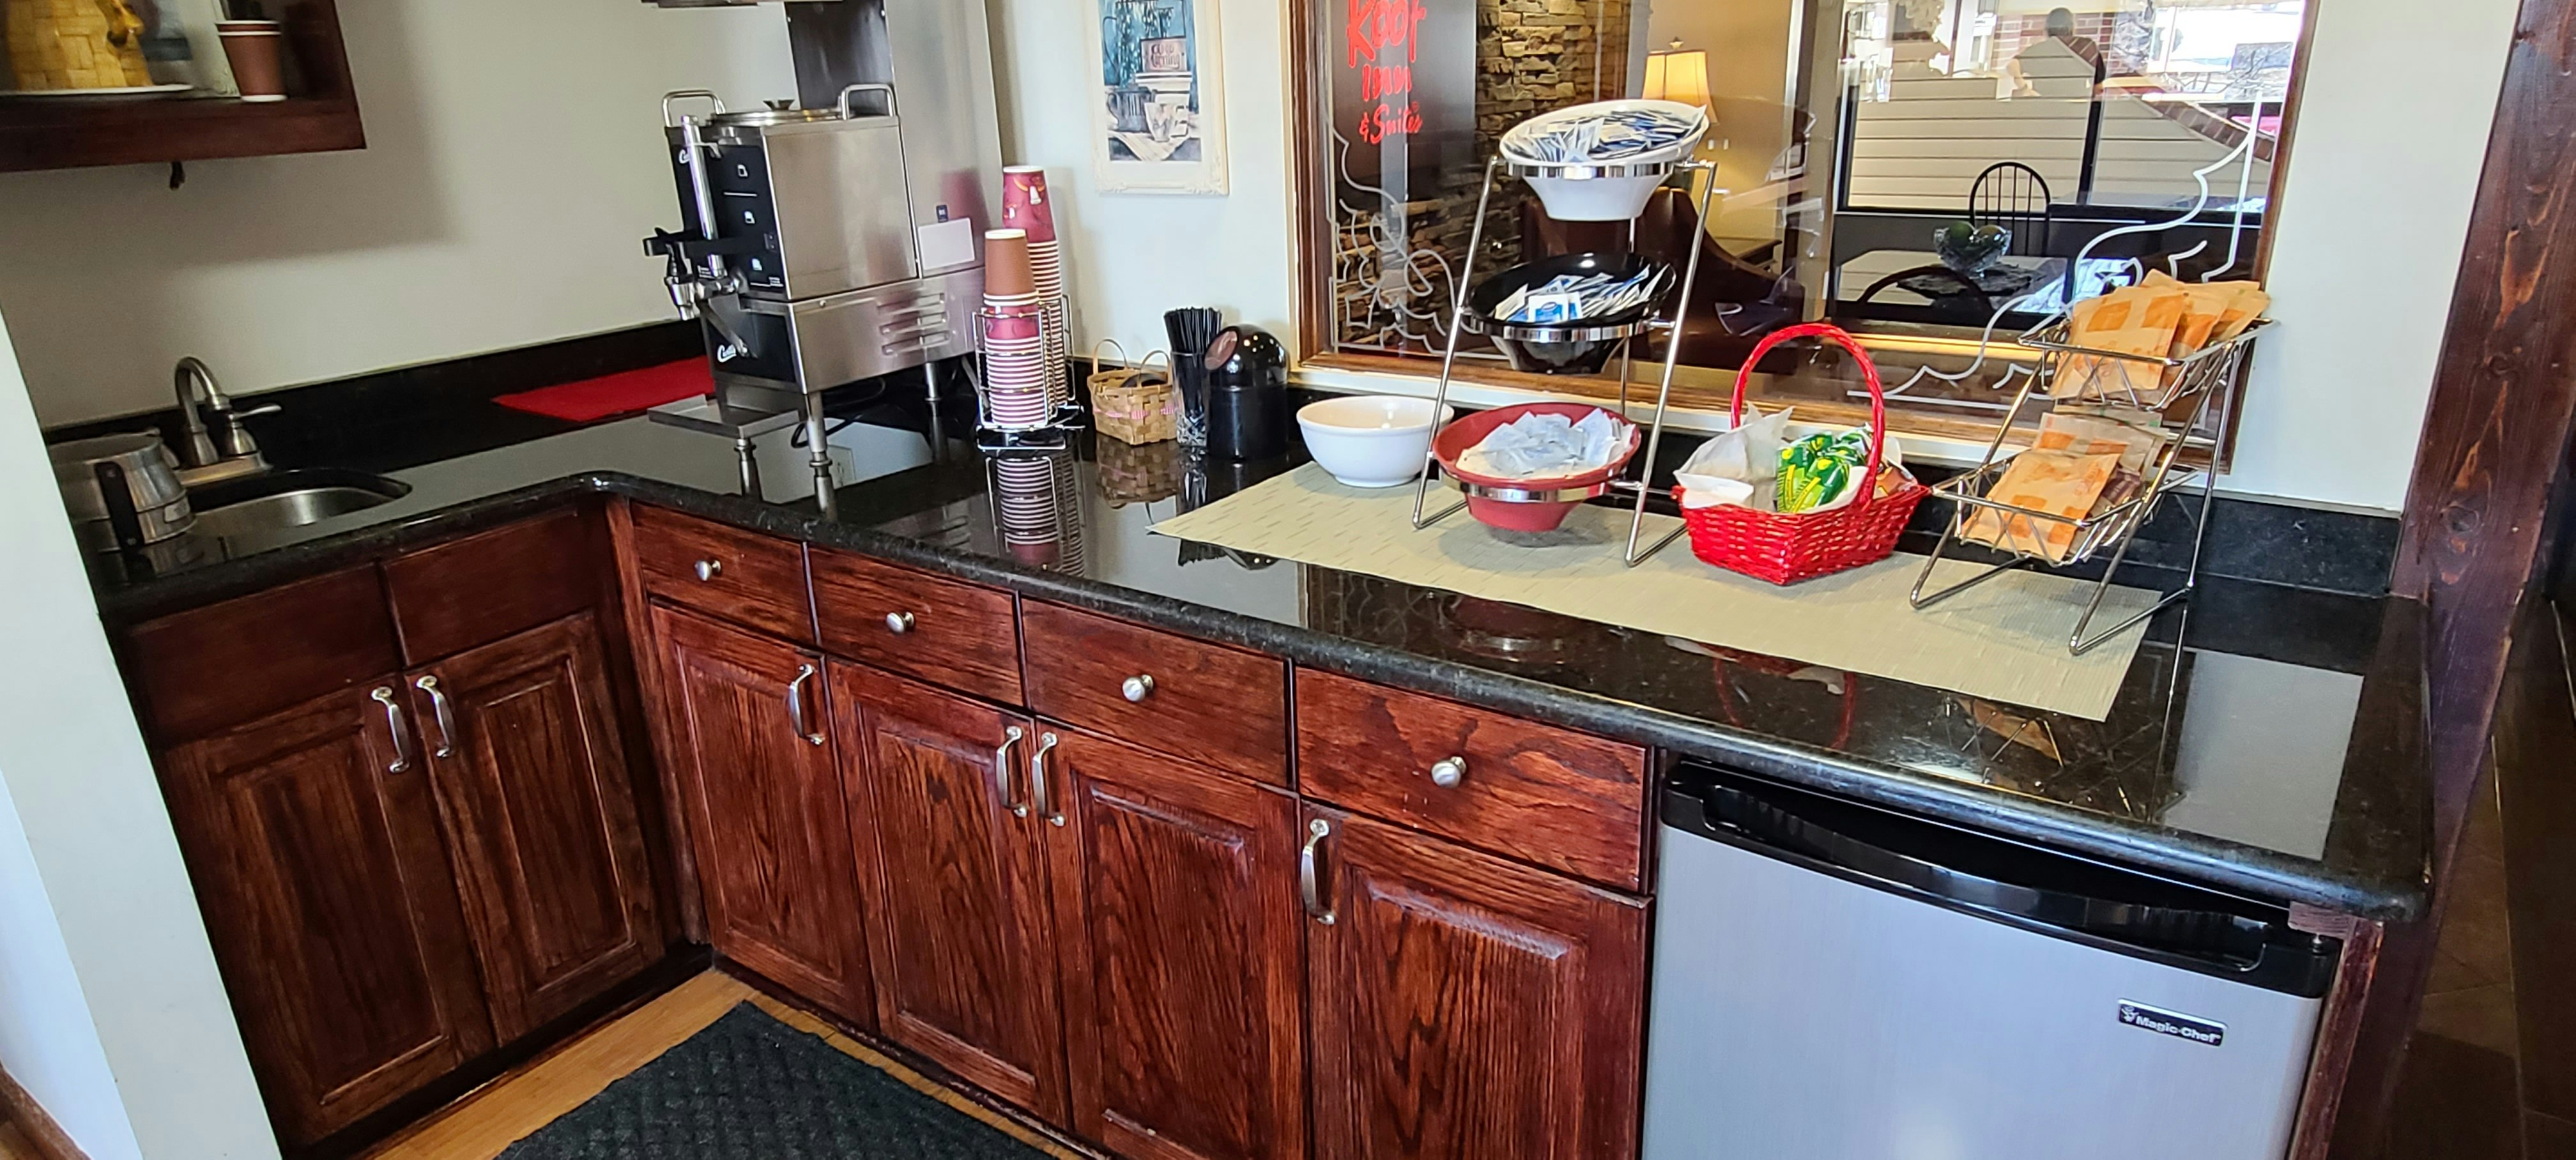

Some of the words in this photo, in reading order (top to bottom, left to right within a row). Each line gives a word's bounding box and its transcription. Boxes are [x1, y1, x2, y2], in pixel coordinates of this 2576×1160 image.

[1363, 63, 1412, 102] Inn
[1359, 111, 1370, 142] &
[1370, 103, 1423, 144] Suites
[2135, 1015, 2178, 1033] Magic
[2181, 1026, 2221, 1042] Chef
